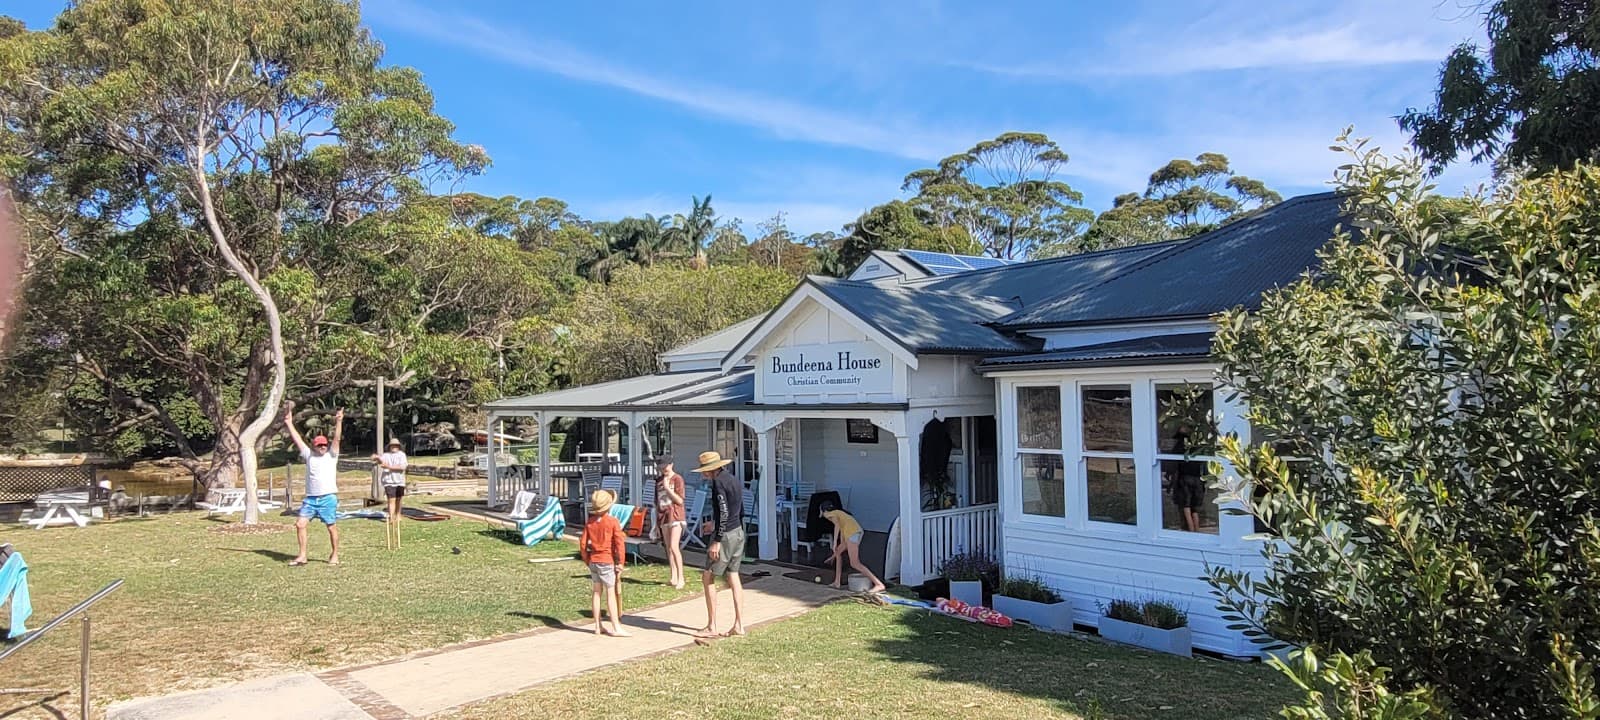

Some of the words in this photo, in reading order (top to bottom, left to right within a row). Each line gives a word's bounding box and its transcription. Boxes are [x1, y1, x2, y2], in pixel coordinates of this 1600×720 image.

[772, 353, 833, 374] Bundeena
[837, 351, 881, 370] House
[787, 376, 819, 386] Christian
[820, 374, 861, 385] Community
